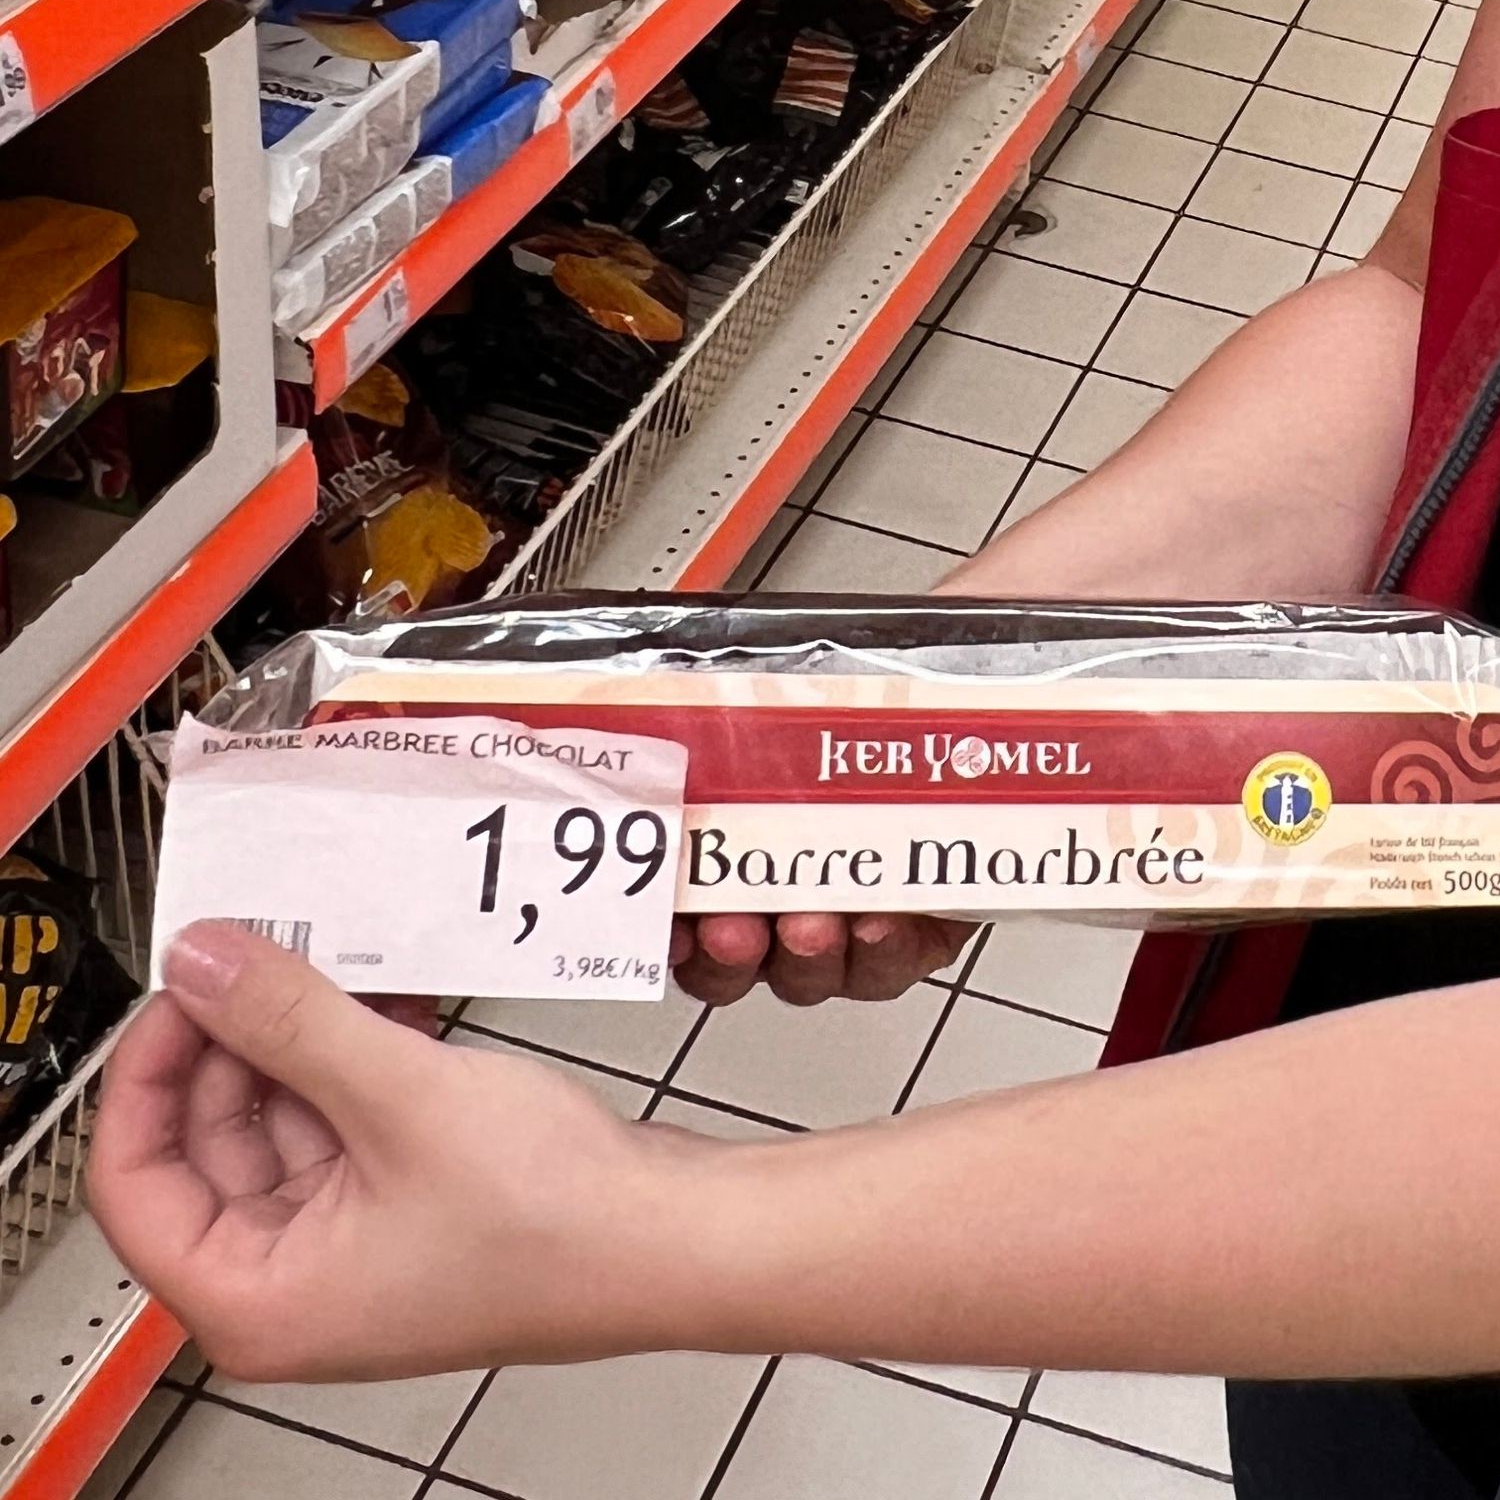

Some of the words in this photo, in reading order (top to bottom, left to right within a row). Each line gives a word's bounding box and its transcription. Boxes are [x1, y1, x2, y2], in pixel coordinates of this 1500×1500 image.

[314, 730, 460, 757] MARBREE
[470, 732, 633, 772] CHOCOLAT
[465, 803, 668, 945] 1,99
[687, 827, 883, 887] Barre
